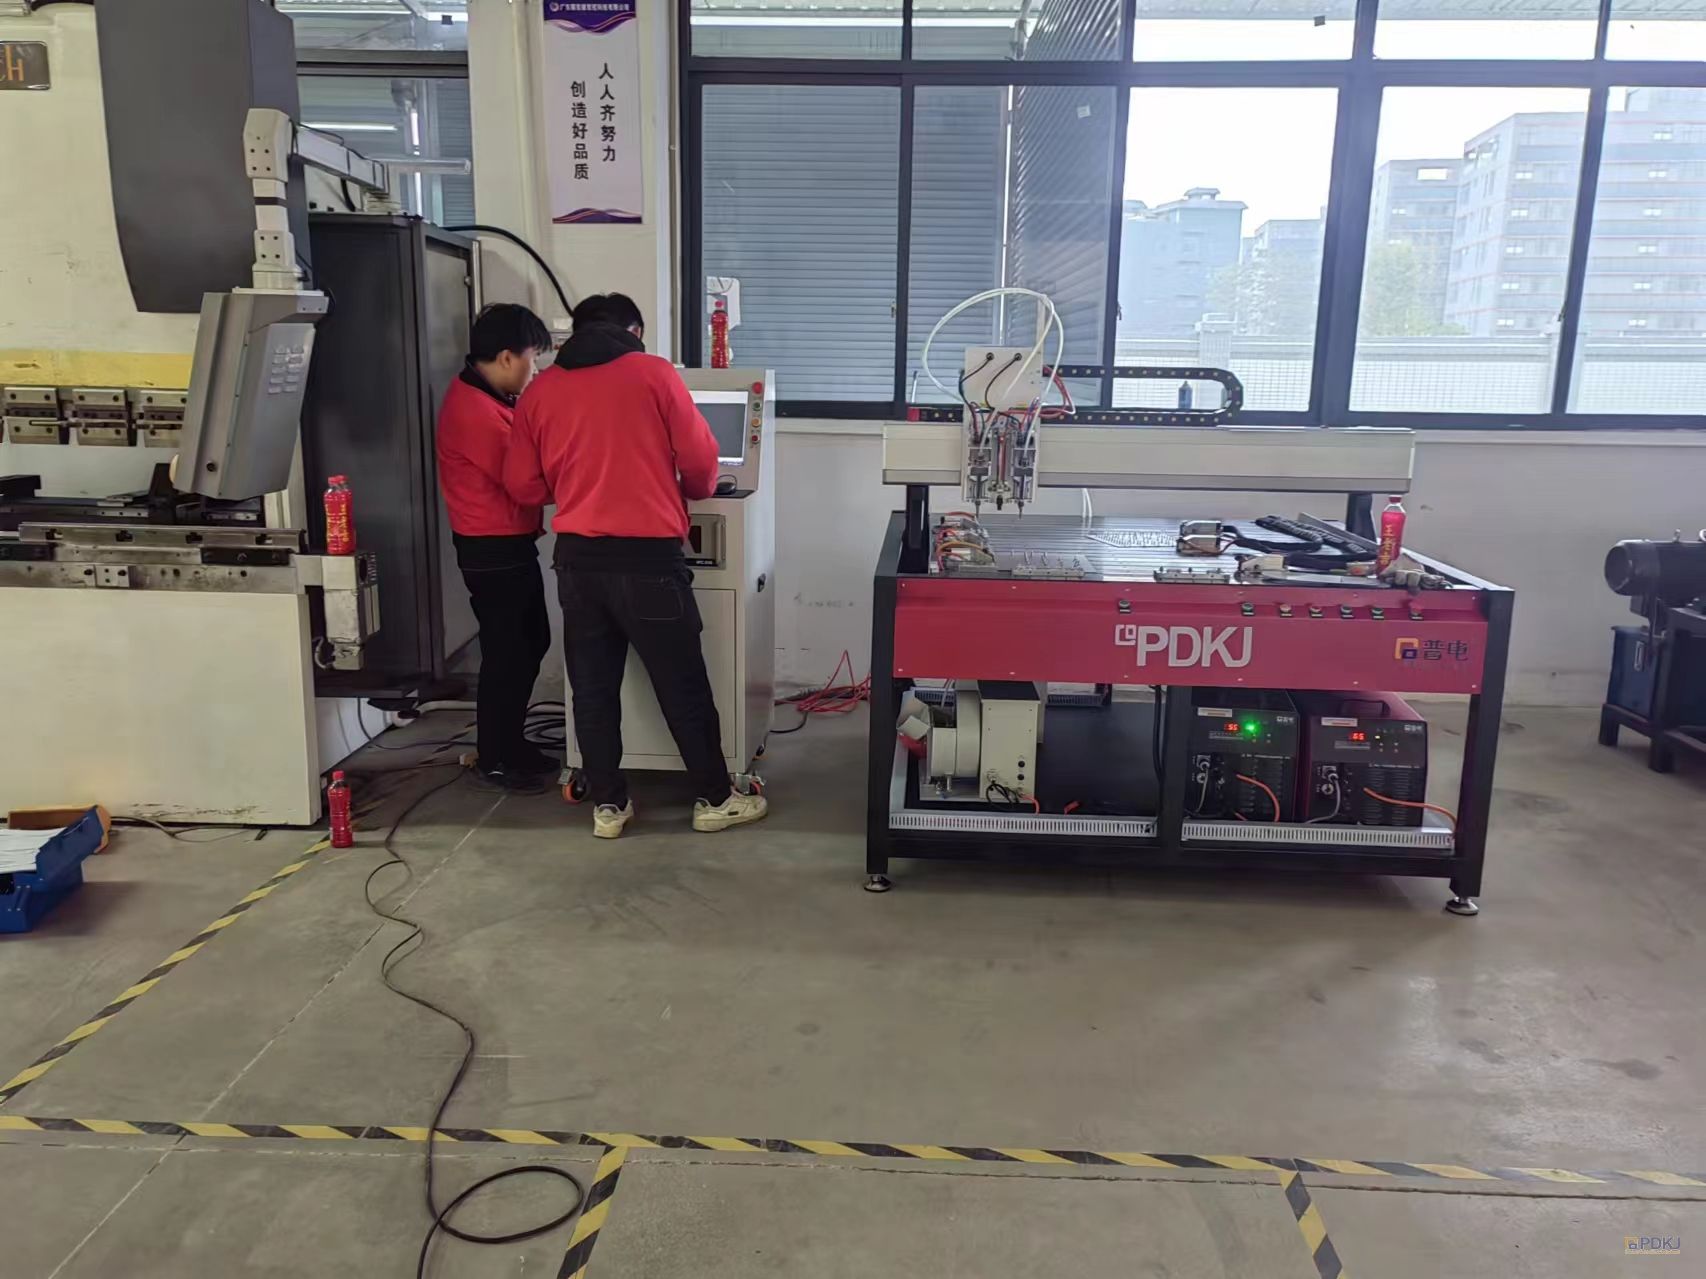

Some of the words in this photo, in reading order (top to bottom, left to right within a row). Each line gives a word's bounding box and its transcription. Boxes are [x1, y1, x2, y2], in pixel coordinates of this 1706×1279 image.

[570, 81, 589, 180] 创造好品质
[599, 63, 616, 162] 人人齐努力
[1136, 625, 1253, 668] PDKJ
[1422, 640, 1469, 661] 普电
